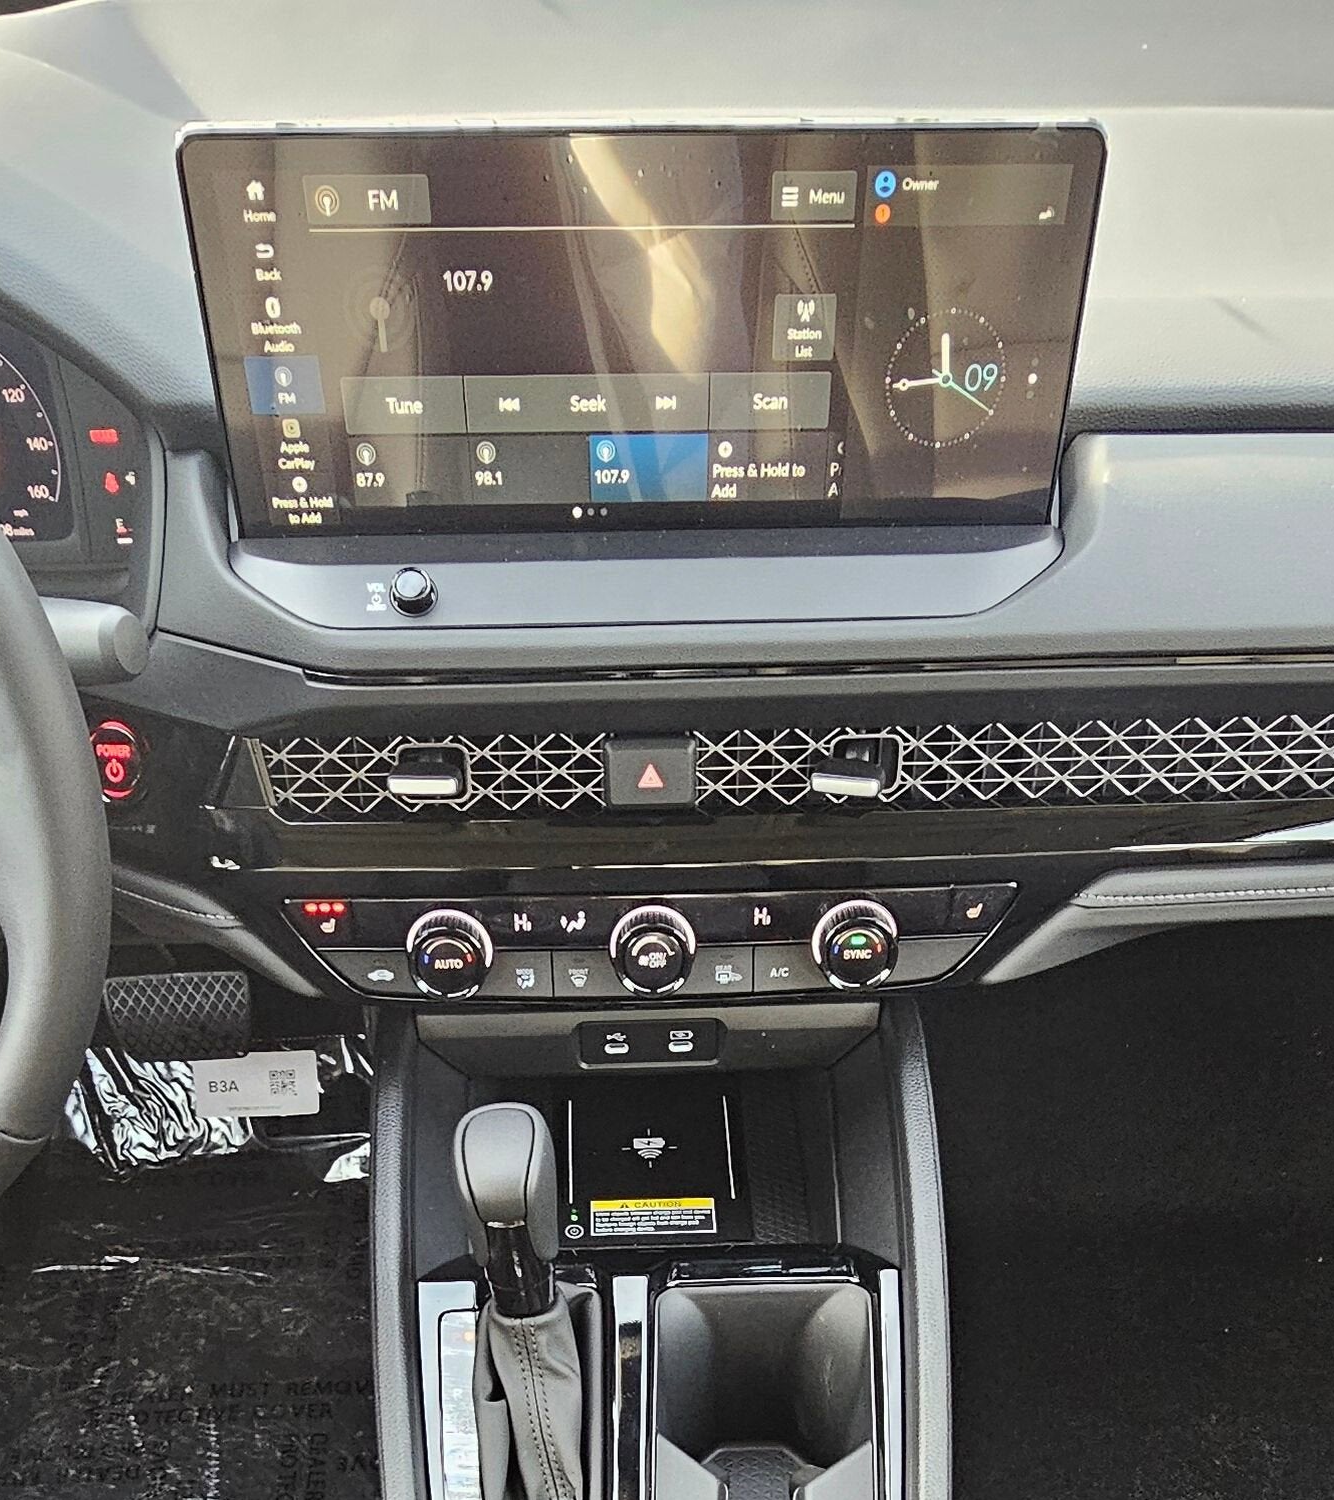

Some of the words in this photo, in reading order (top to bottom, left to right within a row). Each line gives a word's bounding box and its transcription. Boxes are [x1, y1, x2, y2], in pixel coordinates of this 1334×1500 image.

[902, 177, 940, 193] Owner
[367, 189, 399, 211] FM
[808, 188, 845, 205] Menu
[243, 209, 276, 223] Home
[255, 268, 282, 282] Back
[442, 270, 493, 293] 107.9
[251, 322, 302, 336] Bluetooth
[787, 327, 822, 342] Station
[264, 341, 295, 353] Audio
[795, 344, 813, 358] List
[963, 363, 999, 393] 09
[2, 387, 26, 404] 120
[278, 393, 297, 405] FM
[752, 393, 788, 412] Scan
[385, 397, 423, 416] Tune
[569, 395, 607, 412] Seek
[26, 436, 50, 452] 140
[280, 440, 310, 455] Apple
[277, 457, 315, 471] CarPlay
[712, 462, 746, 478] Press
[747, 463, 759, 478] &
[760, 462, 789, 478] Hold
[790, 464, 806, 478] to
[355, 472, 385, 488] 87.9
[475, 469, 503, 486] 98.1
[594, 468, 631, 485] 107.9
[27, 484, 49, 499] 160
[711, 482, 737, 499] Add
[271, 496, 299, 509] Press
[309, 496, 334, 509] Hold
[288, 513, 301, 525] to
[301, 511, 323, 524] Add
[366, 582, 386, 593] VOL
[95, 744, 132, 759] POWER
[843, 948, 873, 961] SYNC
[434, 957, 464, 970] AUTO
[769, 966, 789, 979] A/C
[208, 1080, 240, 1094] B3A
[633, 1200, 682, 1209] CAUTION
[285, 1377, 371, 1397] REMOV
